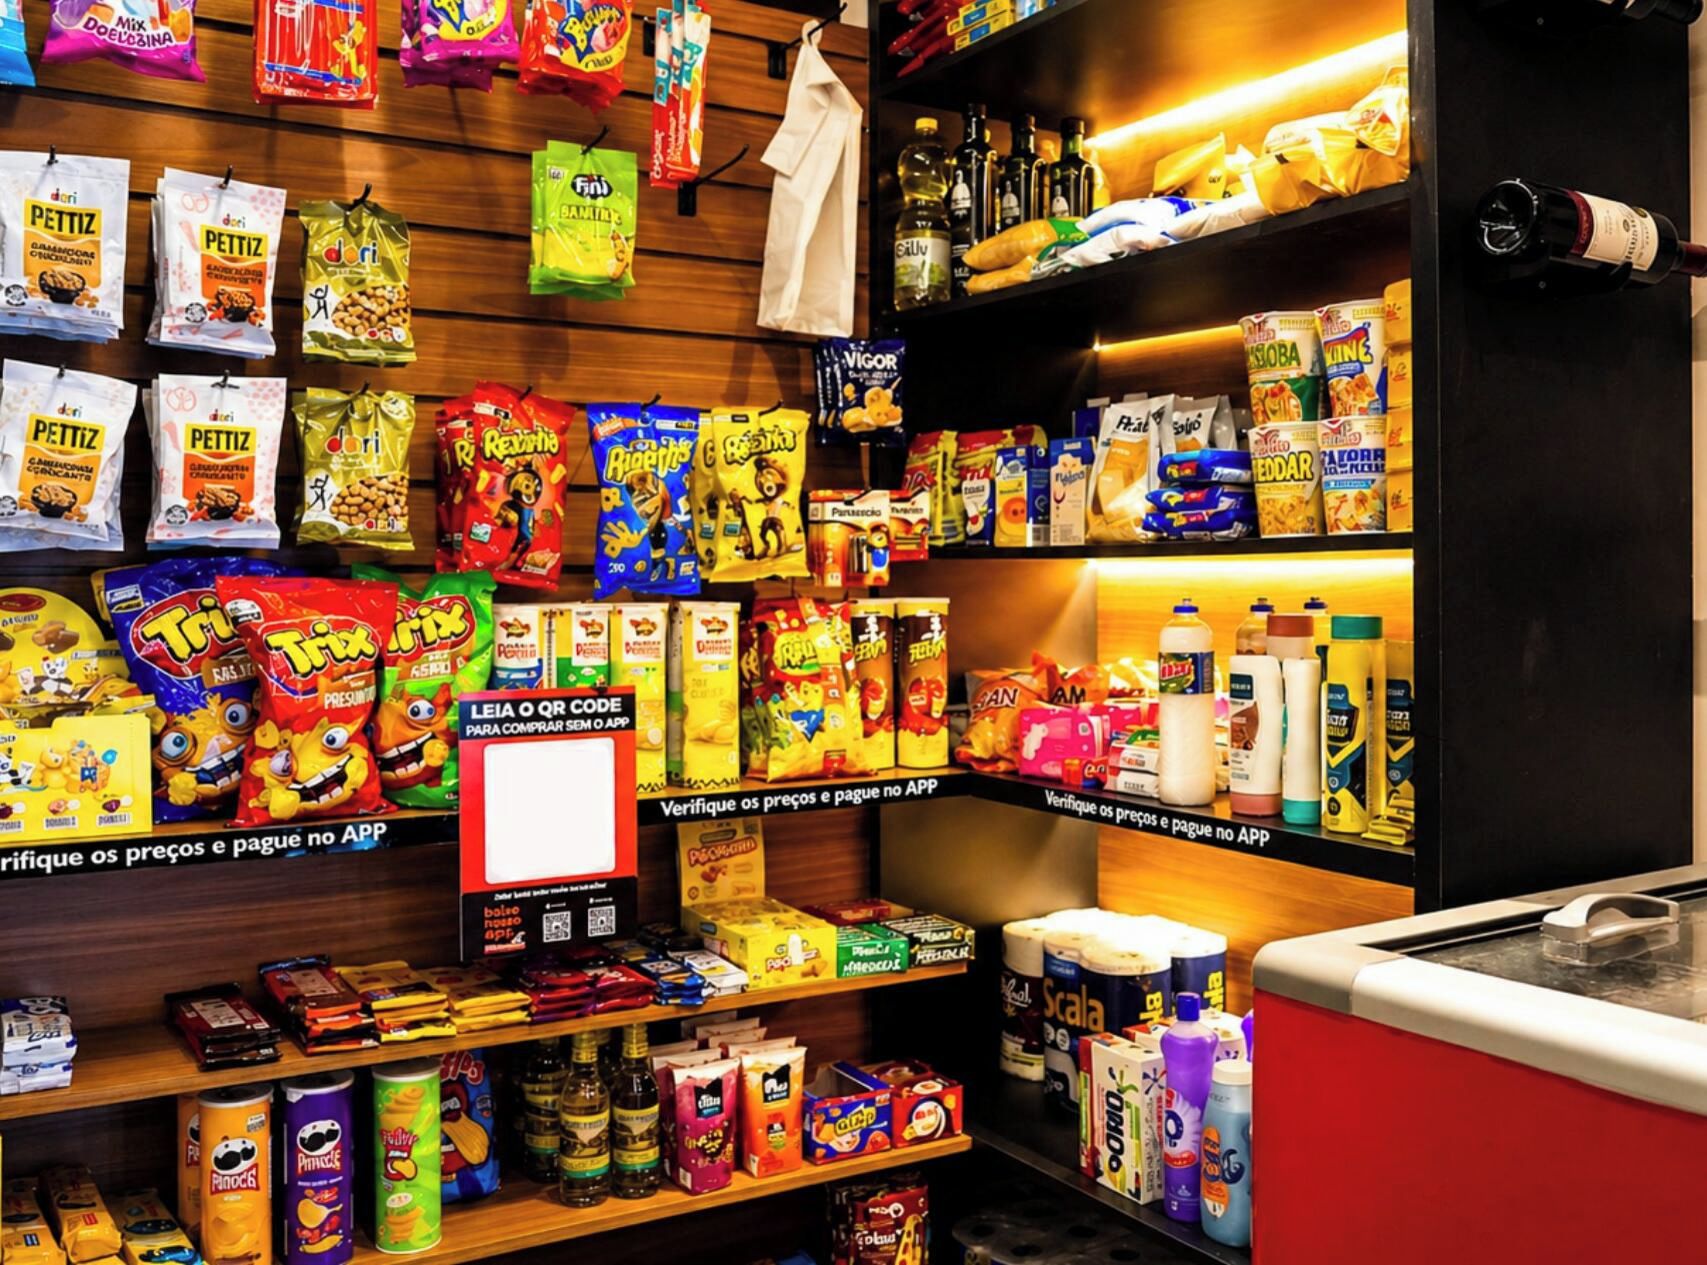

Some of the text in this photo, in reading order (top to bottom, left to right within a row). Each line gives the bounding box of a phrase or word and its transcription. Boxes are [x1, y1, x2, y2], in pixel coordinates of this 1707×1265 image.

[31, 204, 96, 235] PETTIZ
[205, 229, 263, 257] PETTIZ
[323, 238, 379, 264] dori
[843, 351, 898, 371] VIGOR
[191, 428, 250, 451] PETTIZ
[325, 426, 381, 455] dori
[264, 622, 378, 680] Trix
[471, 697, 622, 719] LEIA O QR CODE
[466, 716, 630, 736] PARA COMPRAR SEM O APP
[660, 778, 938, 817] Verifique os preços e pague no APP
[1045, 790, 1270, 847] Verifique os preços e pague no APP
[91, 849, 118, 864] os
[126, 842, 205, 867] preços
[212, 840, 226, 854] e
[233, 834, 301, 858] pague
[308, 832, 335, 846] no
[341, 822, 387, 844] APP
[1043, 977, 1105, 1032] Scala
